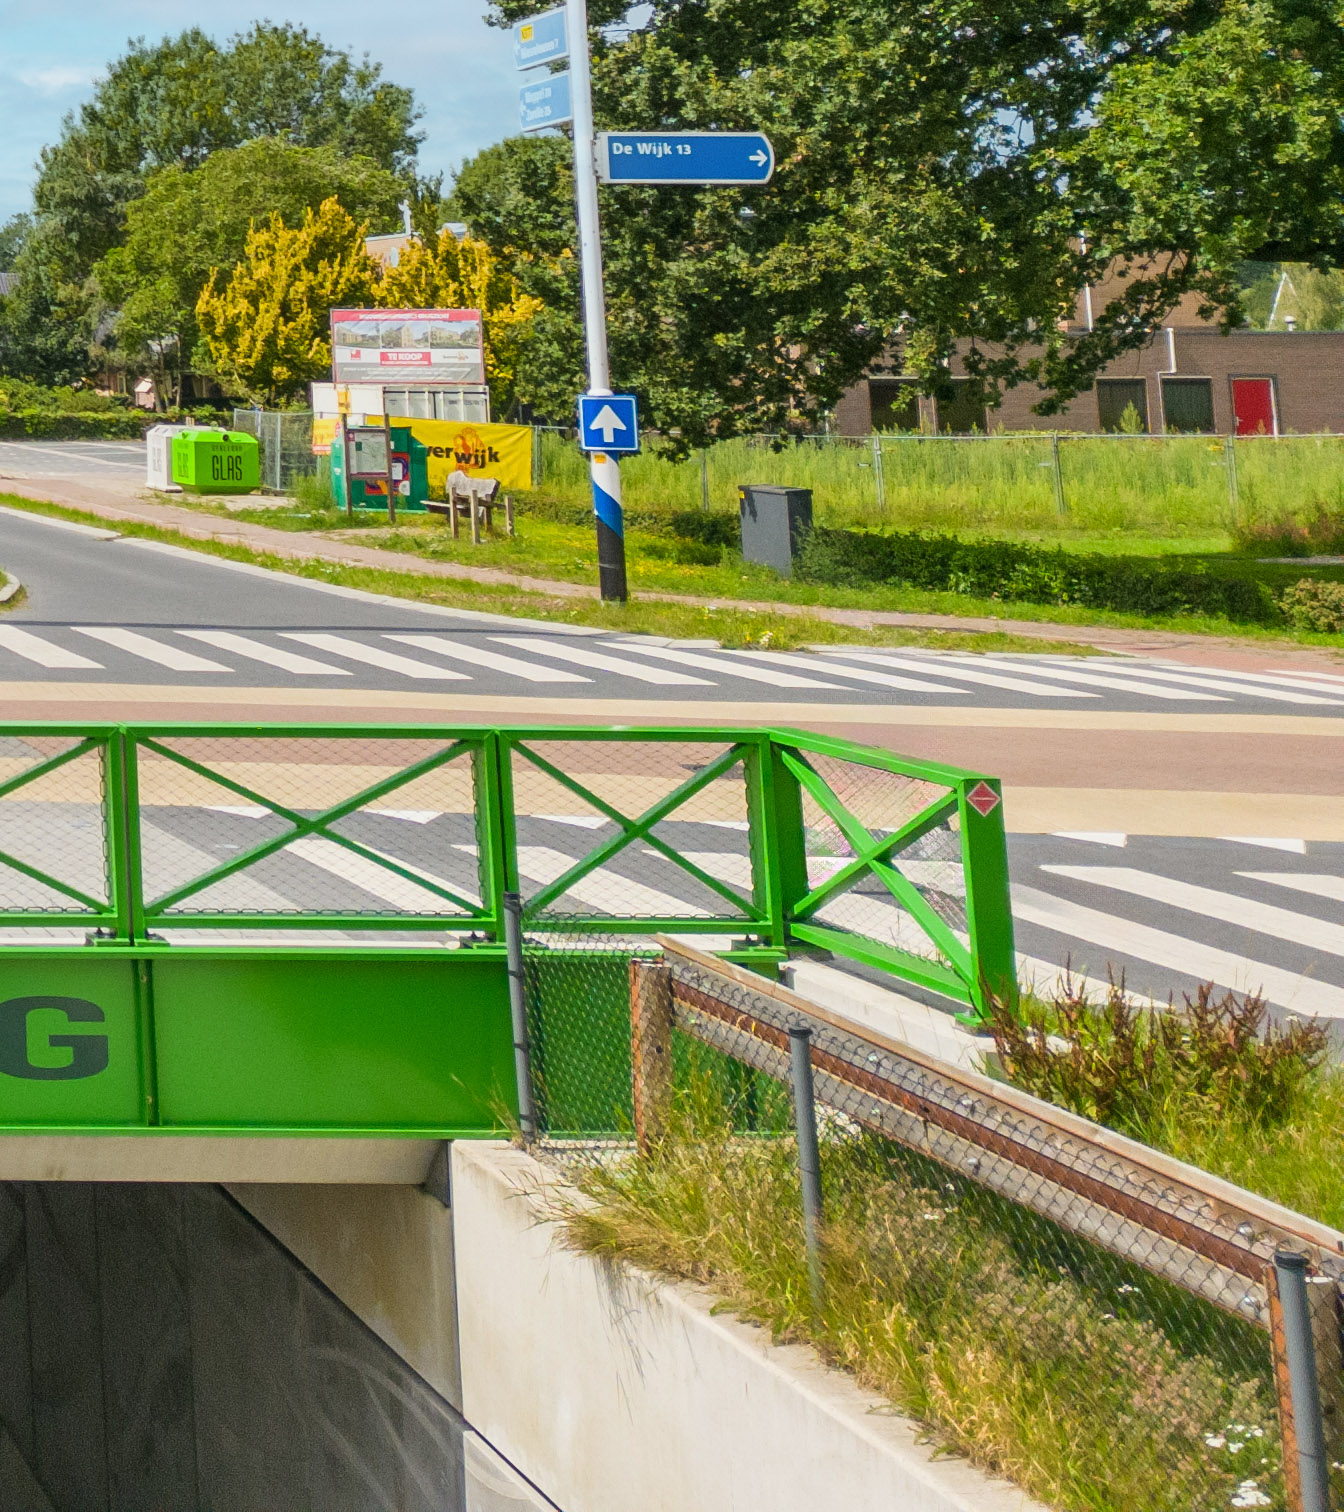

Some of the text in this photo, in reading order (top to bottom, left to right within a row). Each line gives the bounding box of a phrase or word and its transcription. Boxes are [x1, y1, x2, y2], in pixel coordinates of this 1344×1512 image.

[613, 142, 691, 158] De Wijk 13
[212, 455, 242, 481] GLAS
